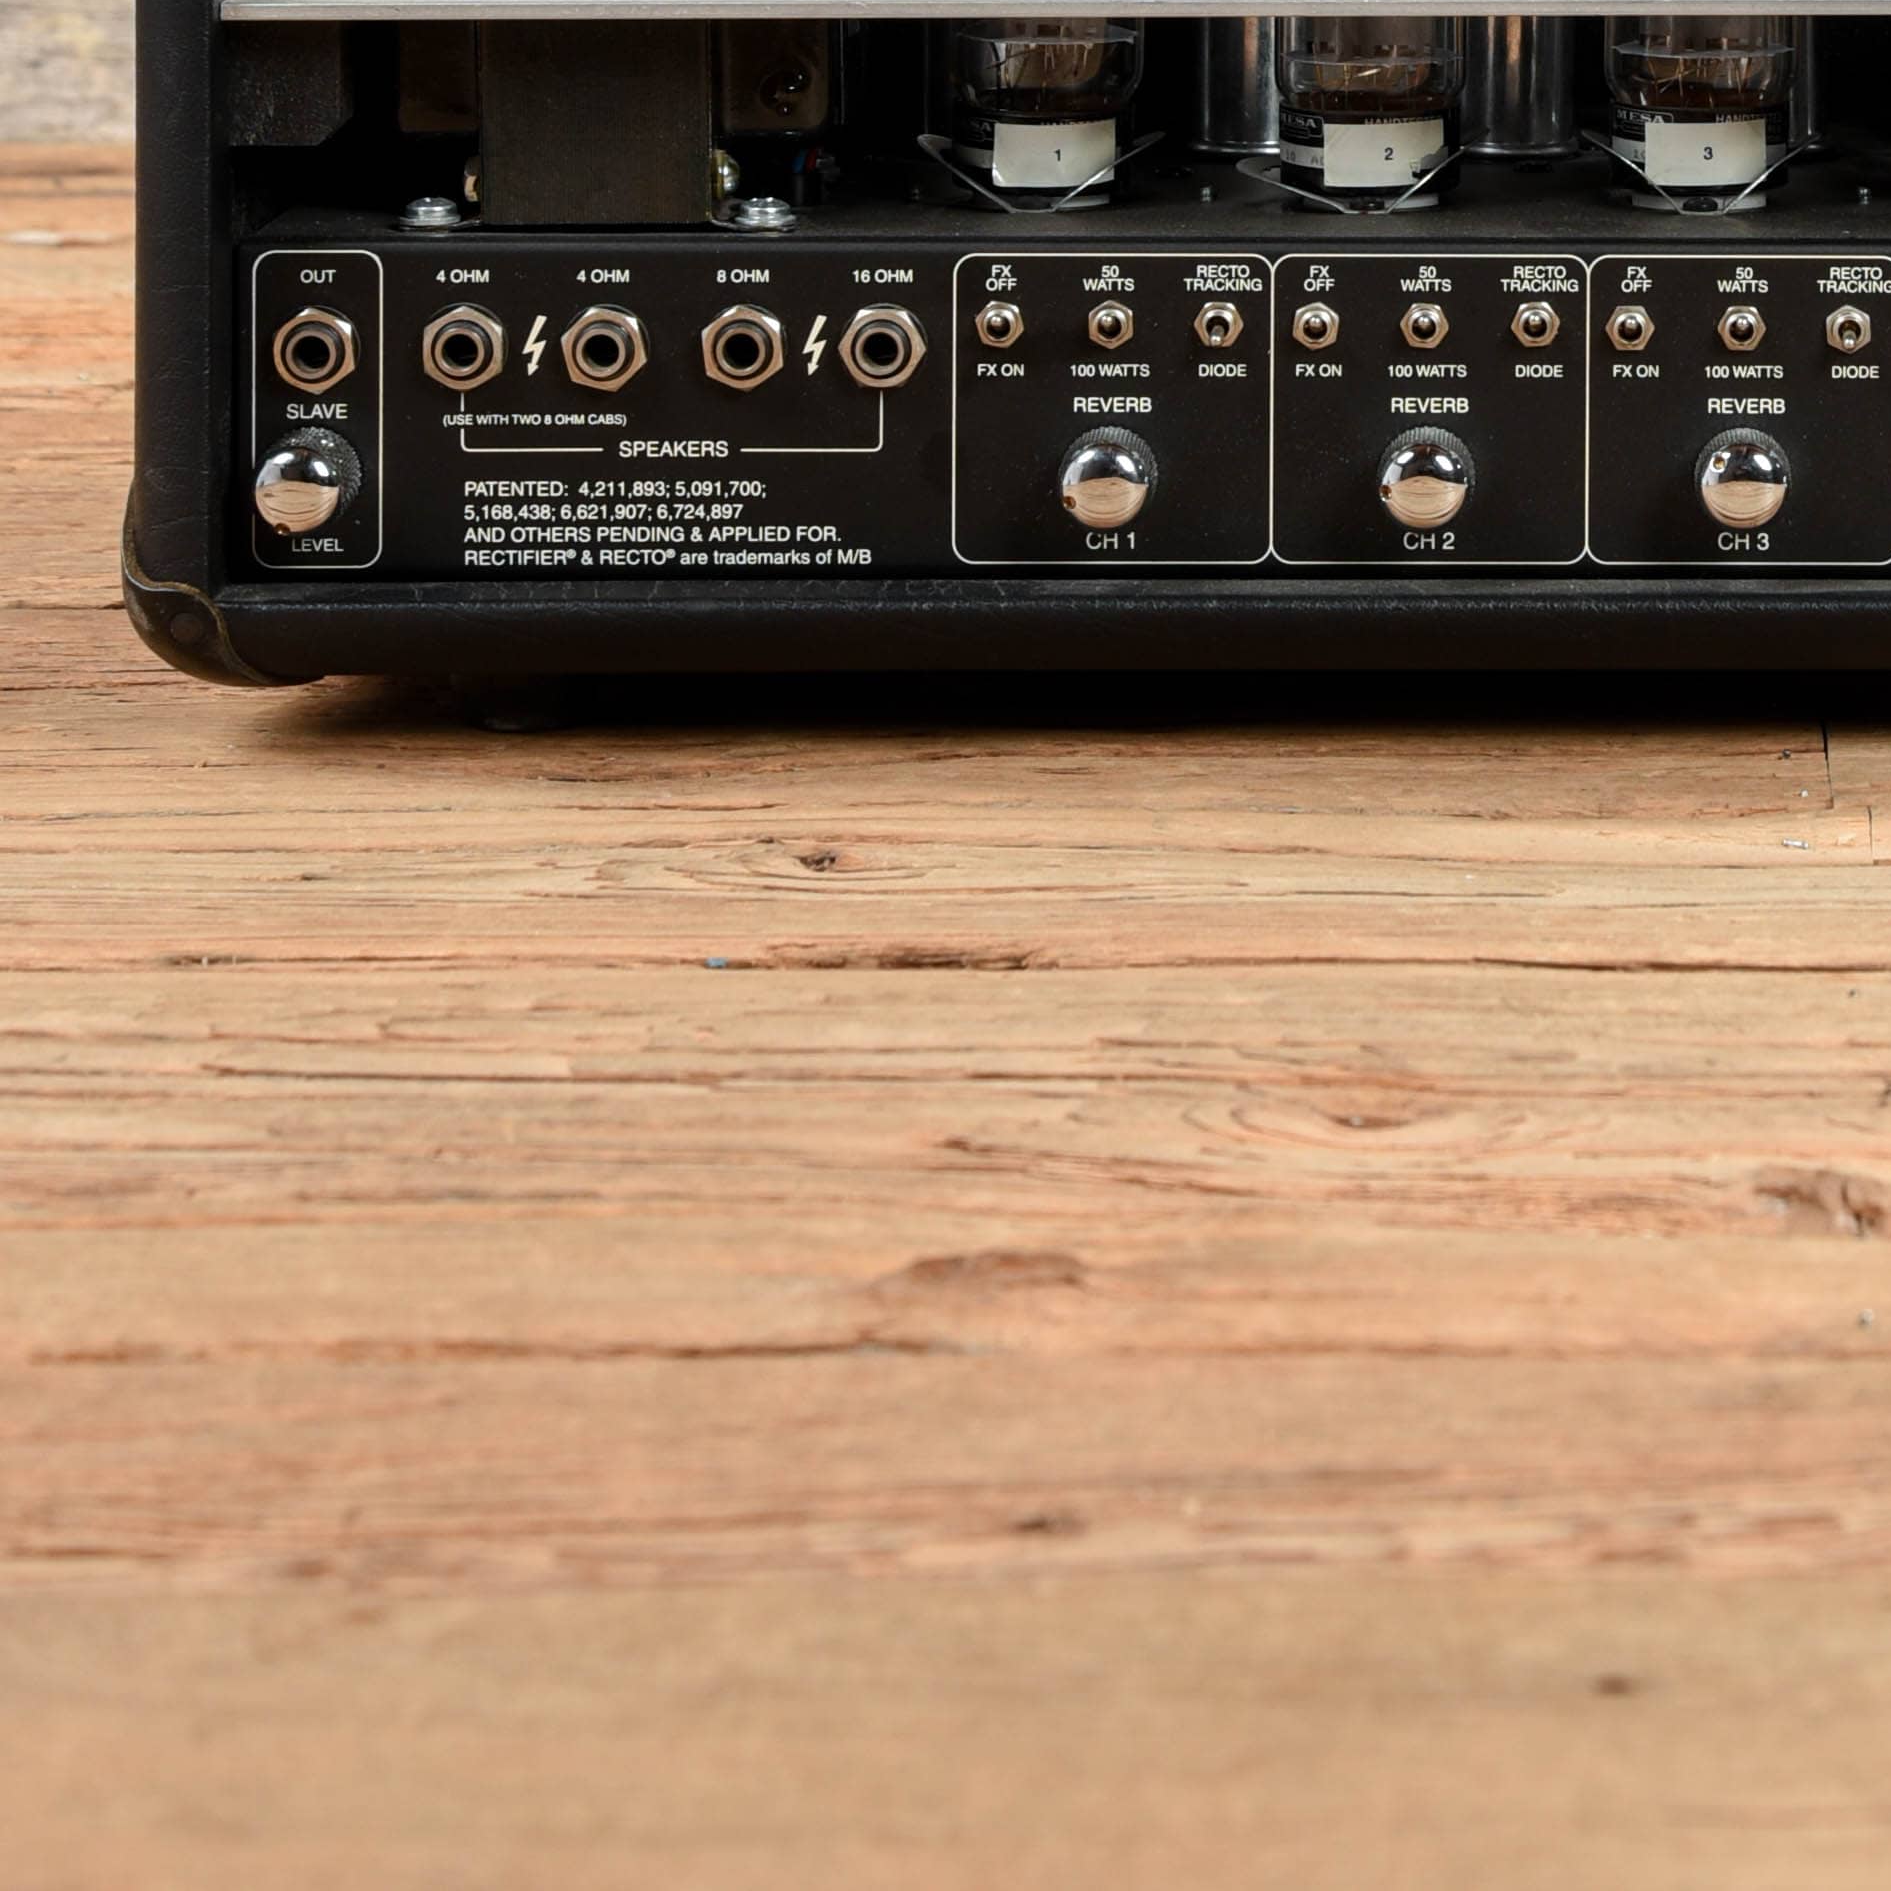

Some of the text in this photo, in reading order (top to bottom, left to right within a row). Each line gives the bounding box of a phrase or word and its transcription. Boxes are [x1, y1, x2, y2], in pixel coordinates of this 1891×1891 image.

[1053, 148, 1062, 161] 1
[1384, 146, 1394, 161] 2
[1703, 146, 1714, 160] 3
[299, 269, 337, 284] OUT
[435, 268, 490, 284] 4 OHM
[576, 268, 630, 284] 4 OHM
[716, 268, 770, 284] 8 OHM
[852, 268, 914, 284] 16 OHM
[991, 264, 1012, 278] FX
[1101, 264, 1120, 279] 50
[1196, 264, 1251, 279] RECTO
[985, 278, 1018, 292] OFF
[1082, 278, 1135, 292] WATTS
[1183, 278, 1263, 292] TRACKING
[977, 363, 1025, 377] FX ON
[1070, 363, 1151, 378] 100 WATTS
[1198, 363, 1247, 378] DIODE
[286, 403, 348, 420] SLAVE
[1073, 396, 1153, 413] REVERB
[442, 413, 629, 428] (USE WITH TWO 8 OHM CABS)
[618, 440, 729, 458] SPEAKERS
[464, 480, 767, 499] PATENTED: 4,211,893; 5,091,700;
[463, 503, 745, 523] 5,168,438; 6,621,907; 6,724,897
[463, 525, 842, 543] AND OTHERS PENDING & APPLIED FOR.
[1085, 531, 1135, 550] CH 1
[1403, 531, 1456, 550] CH 2
[1717, 532, 1770, 551] CH 3
[292, 537, 345, 553] LEVEL
[580, 549, 594, 566] &
[679, 552, 709, 566] are
[712, 548, 811, 565] trademarks
[815, 548, 833, 565] of
[837, 548, 872, 565] M/B
